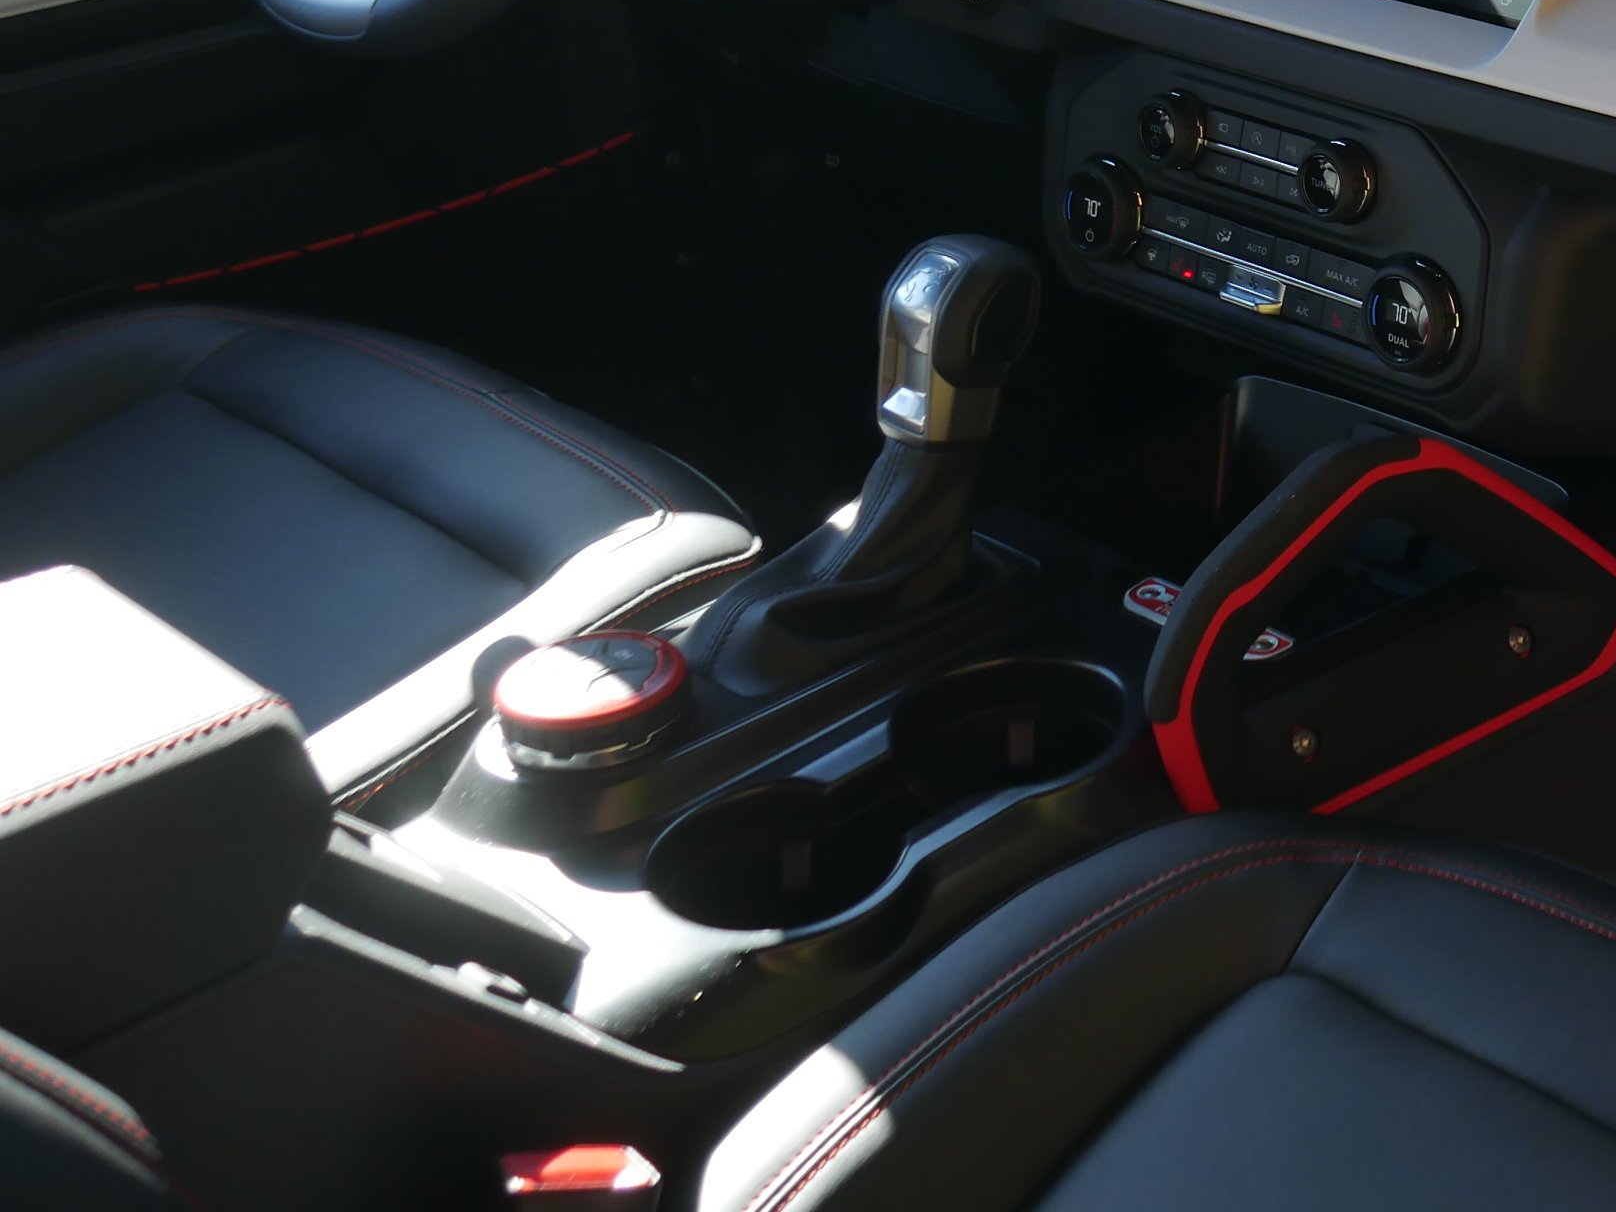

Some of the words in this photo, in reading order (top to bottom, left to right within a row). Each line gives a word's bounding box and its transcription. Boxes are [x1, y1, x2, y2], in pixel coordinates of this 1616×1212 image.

[1246, 242, 1268, 257] AUTO
[1326, 269, 1344, 283] MAX
[1344, 274, 1360, 288] A/C
[1295, 305, 1310, 318] A/C
[1387, 333, 1410, 348] DUAL
